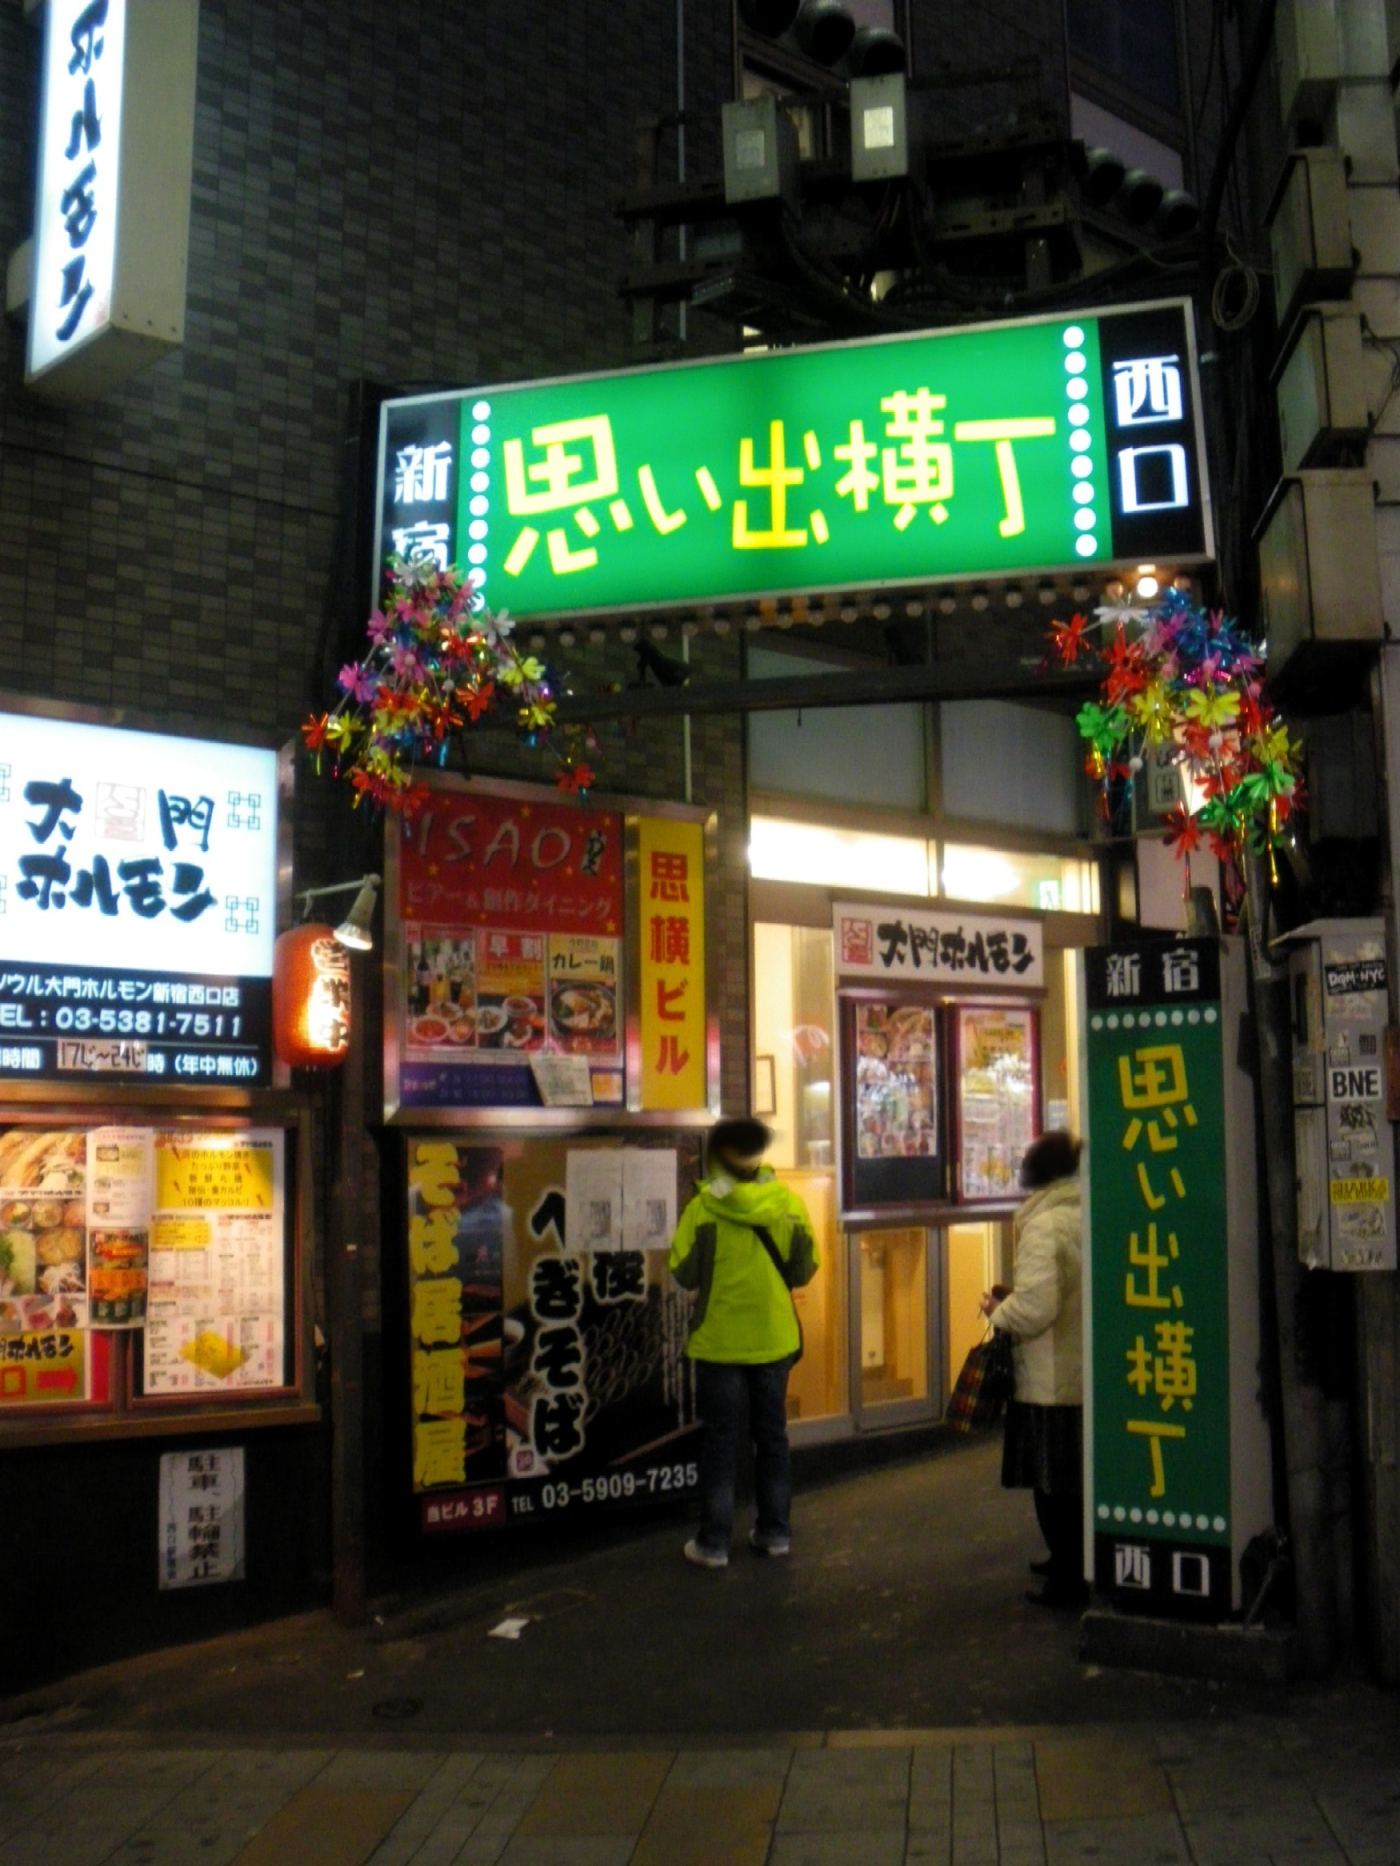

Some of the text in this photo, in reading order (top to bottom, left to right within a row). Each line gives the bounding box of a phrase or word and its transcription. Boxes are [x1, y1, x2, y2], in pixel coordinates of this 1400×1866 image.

[1111, 353, 1190, 516] 西口
[502, 386, 1058, 578] 思い出横丁
[414, 806, 572, 870] ISAO
[16, 844, 218, 923] ホルモン
[649, 850, 691, 1076] 思横ビル
[877, 918, 1034, 975] 大門ホルモン
[1104, 947, 1200, 999] 新宿
[55, 1006, 241, 1038] 03-5381-7511
[1332, 1070, 1379, 1098] BNE
[1119, 1043, 1200, 1498] 思い出横丁
[427, 1496, 498, 1523] 当ビル 3F
[512, 1464, 699, 1513] TEL 03-5909-7235
[1115, 1545, 1211, 1597] 西口
